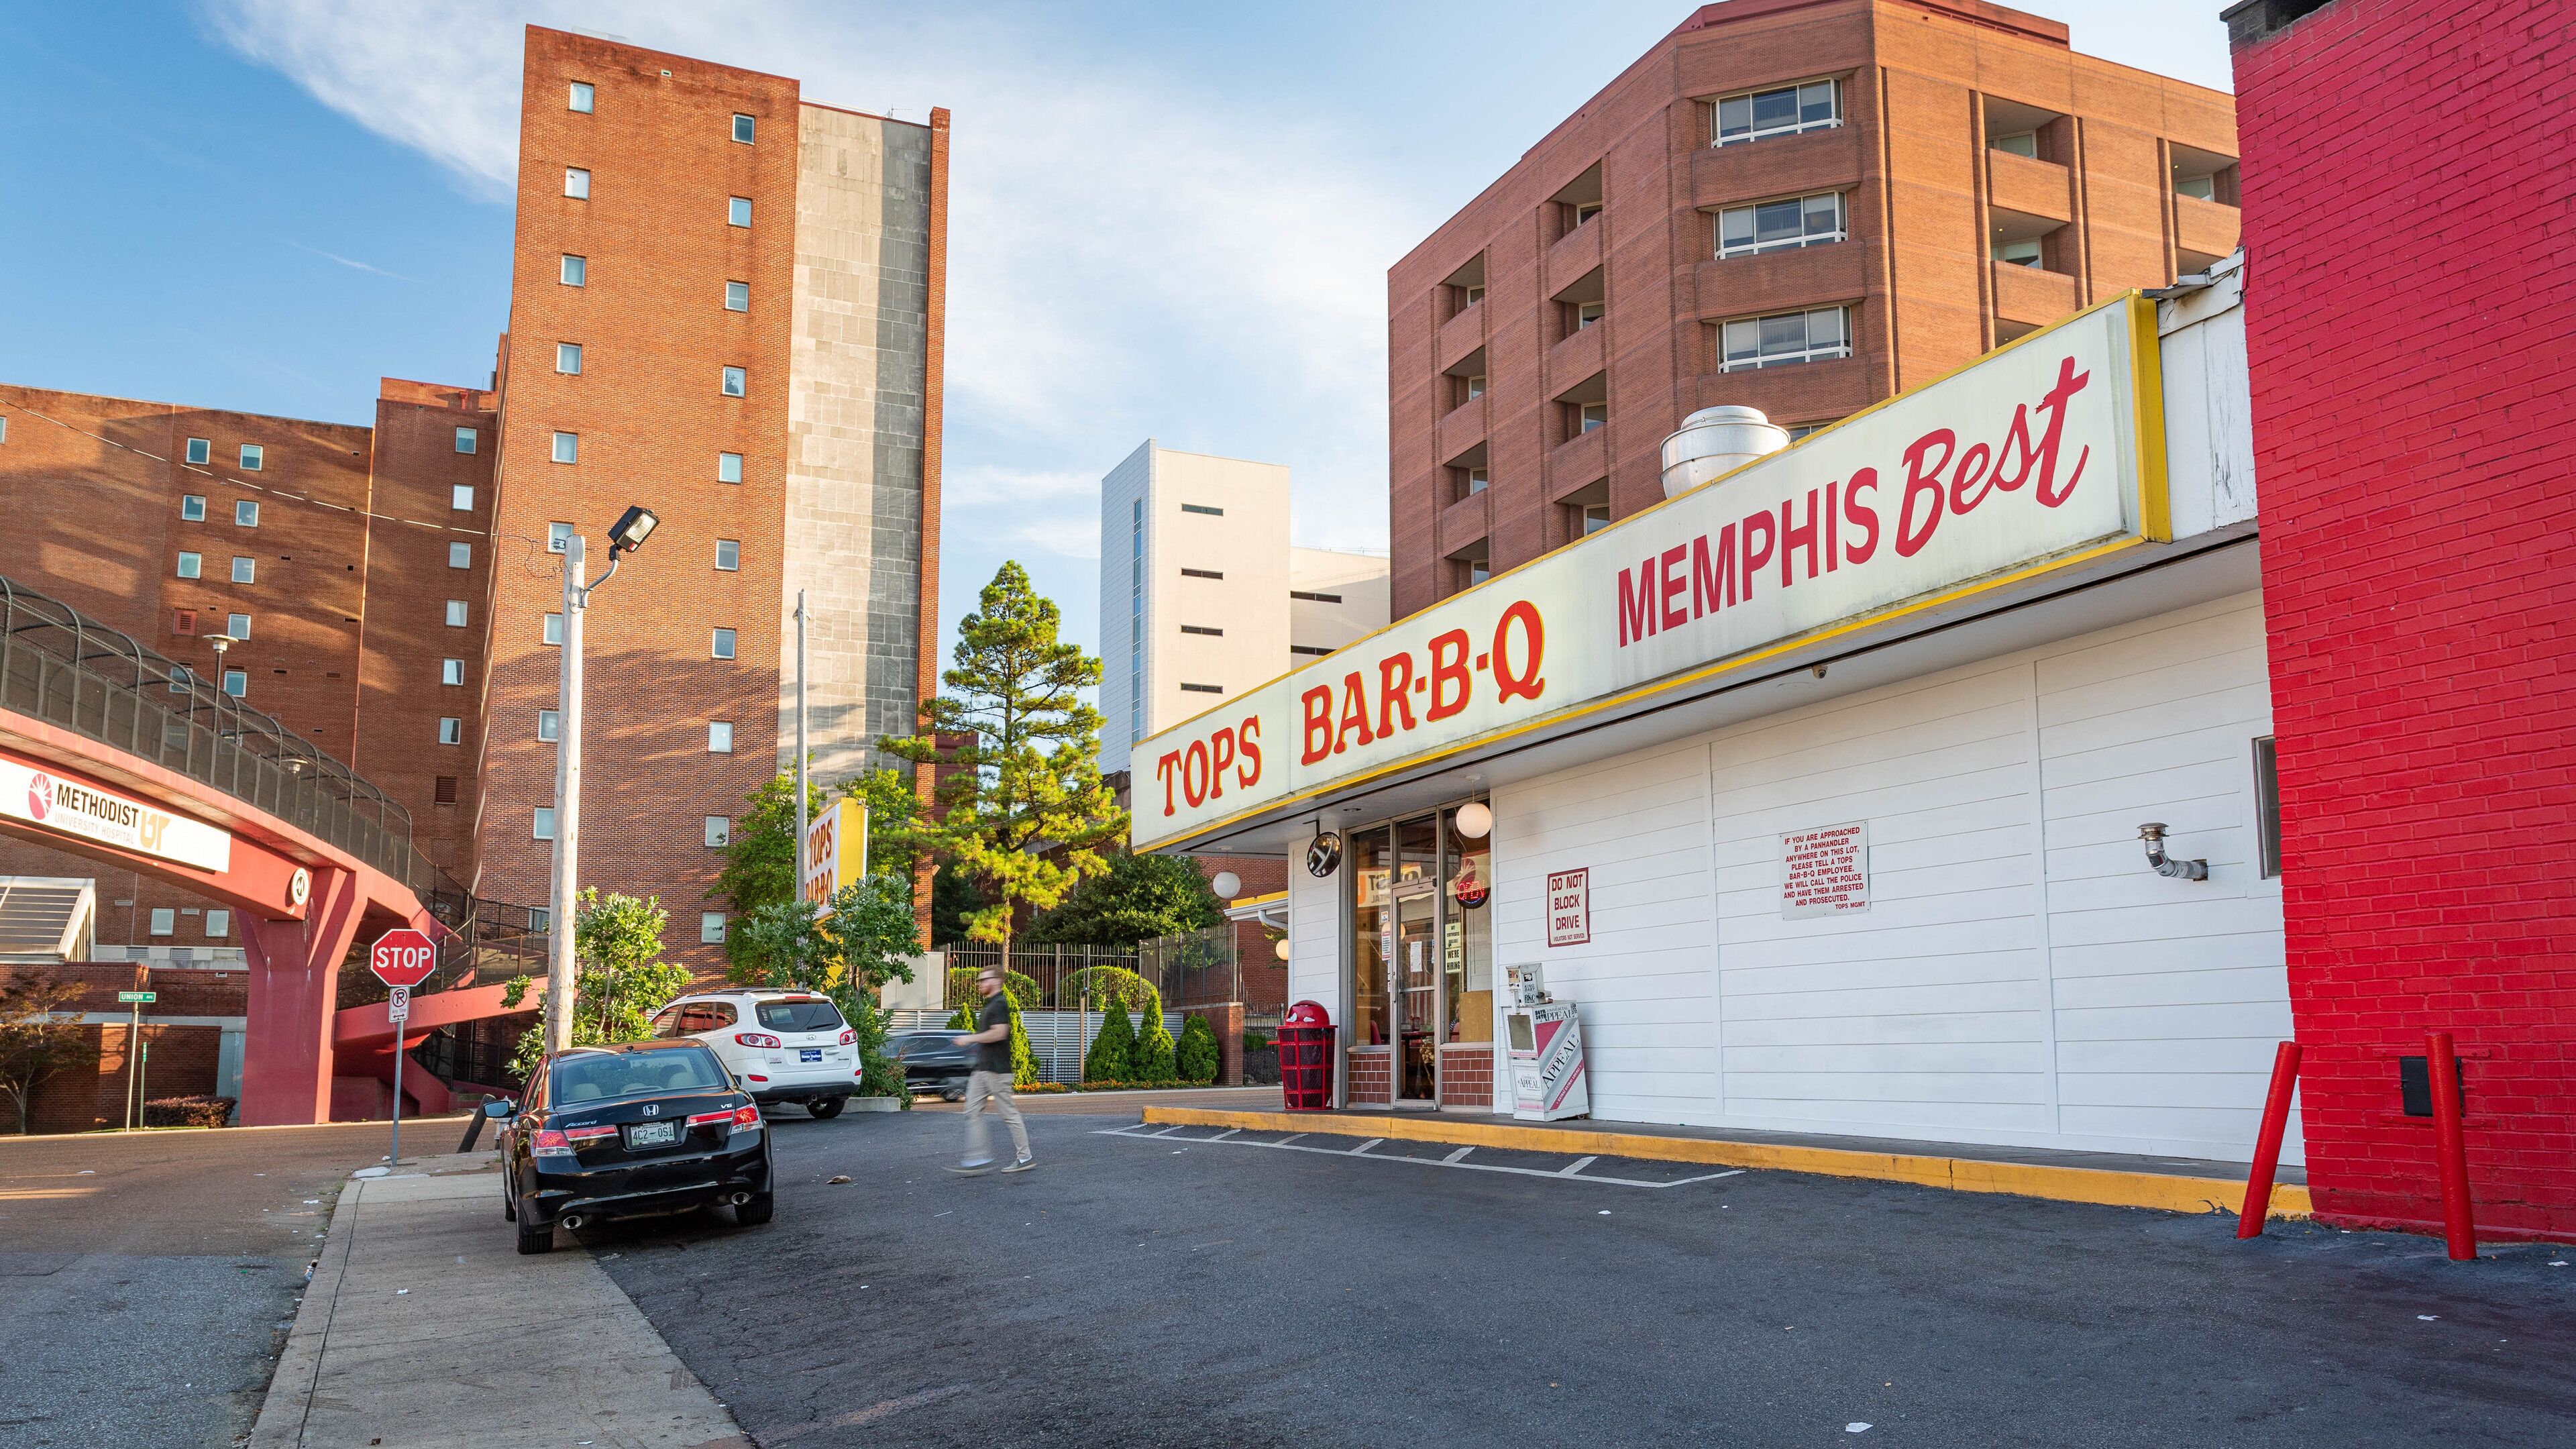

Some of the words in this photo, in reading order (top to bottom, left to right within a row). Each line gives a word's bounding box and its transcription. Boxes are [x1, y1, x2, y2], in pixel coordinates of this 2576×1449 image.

[1157, 714, 1262, 817] TOPS
[1301, 600, 1545, 766] BAR-B-Q
[1617, 466, 1880, 648] MEMPHIS
[1894, 356, 2090, 558] Best
[57, 783, 139, 828] METHODIST
[54, 811, 99, 835] UNIVERSITY
[101, 823, 134, 845] HOSPITAL
[1820, 827, 1860, 839] APPROACHED
[809, 817, 833, 870] TOPS
[1811, 838, 1849, 849] PANHANDLER
[1786, 852, 1818, 863] ANYWHERE
[1791, 862, 1813, 870] PLEASE
[1837, 856, 1853, 864] TOPS
[1790, 871, 1815, 879] BAR-B-Q
[1818, 865, 1854, 875] EMPLOYEE.
[1841, 873, 1862, 881] POLICE
[1458, 880, 1485, 900] OPEN
[1552, 877, 1562, 892] DO
[1566, 874, 1583, 889] NOT
[1832, 883, 1864, 893] ARRESTED
[1554, 894, 1580, 910] BLOCK
[1809, 895, 1849, 904] PROSECUTED.
[1556, 914, 1579, 930] DRIVE
[376, 947, 431, 968] STOP
[1448, 950, 1459, 959] WE'RE
[1447, 961, 1460, 971] HIRING
[1542, 1038, 1579, 1089] APPEAL
[1519, 1077, 1540, 1089] APPEAL
[565, 1120, 597, 1128] Accord
